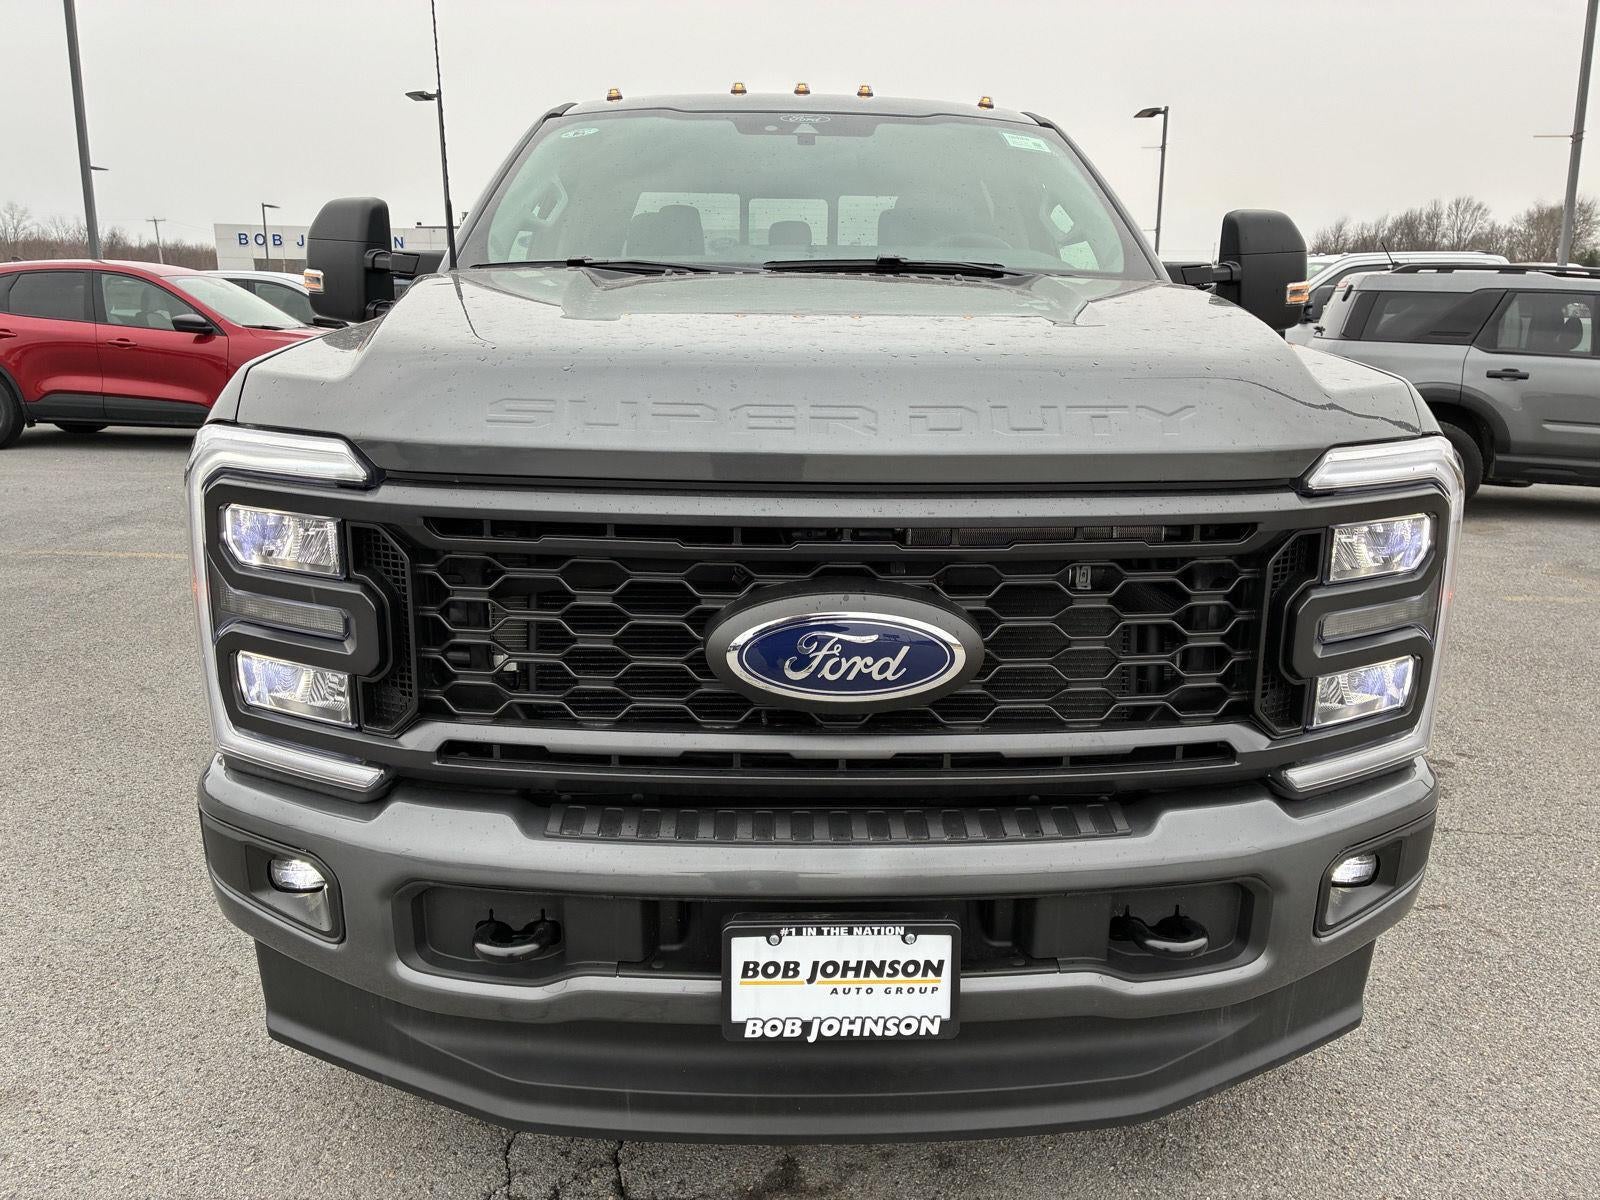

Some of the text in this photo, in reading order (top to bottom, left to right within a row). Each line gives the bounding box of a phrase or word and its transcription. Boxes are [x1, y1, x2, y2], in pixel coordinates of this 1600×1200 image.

[238, 233, 283, 246] BOB
[485, 398, 1197, 437] SUPER DUTY
[784, 631, 910, 680] Ford
[780, 926, 905, 936] #1 IN THE NATION
[741, 959, 945, 985] BOB JOHNSON
[830, 986, 939, 995] AUTO GROUP
[744, 1016, 941, 1043] BOB JOHNSON
